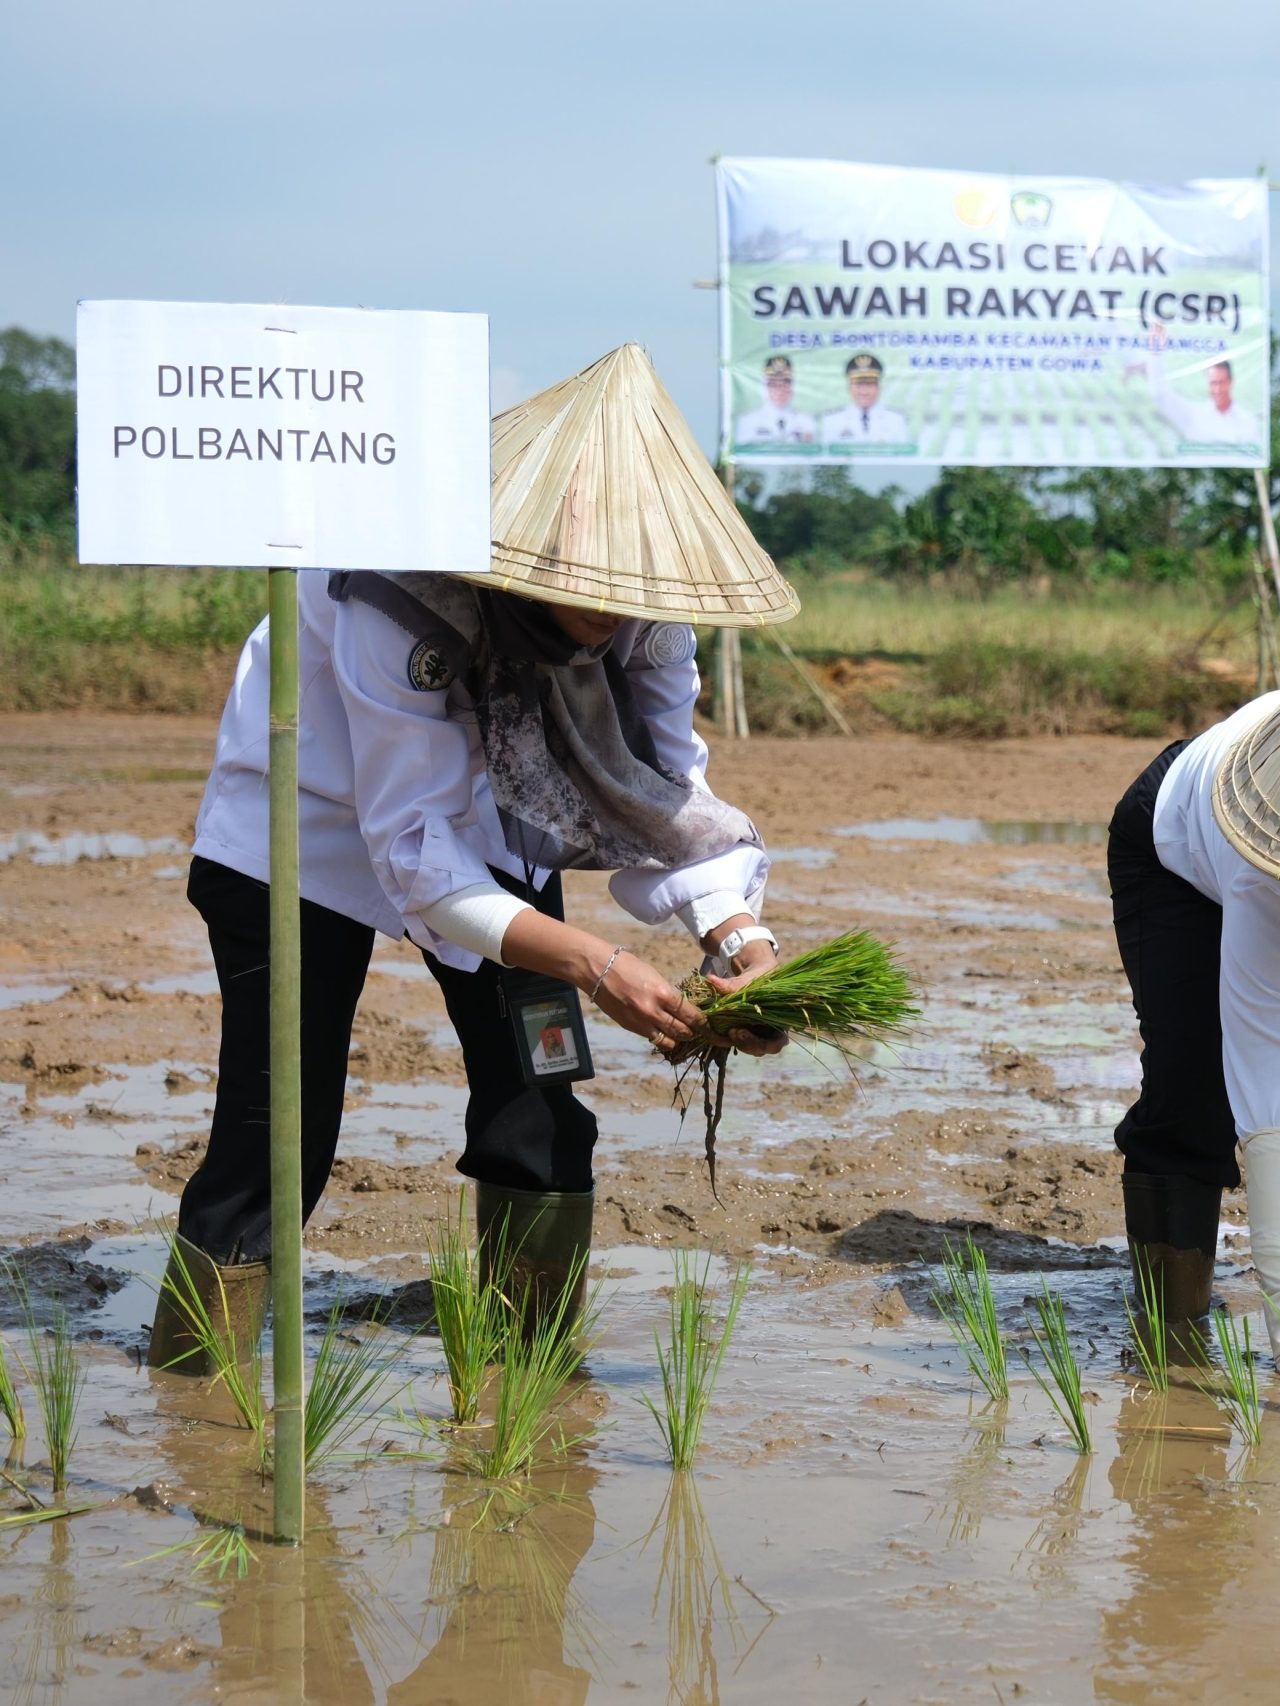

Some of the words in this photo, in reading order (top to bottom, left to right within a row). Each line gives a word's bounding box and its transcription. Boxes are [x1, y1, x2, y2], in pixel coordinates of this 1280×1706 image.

[842, 239, 1005, 270] LOKASI
[1024, 243, 1167, 275] CETAK
[753, 285, 927, 319] SAWAH
[946, 286, 1123, 319] RAKYAT
[1139, 289, 1241, 332] (CSR)
[158, 365, 365, 403] DIREKTUR
[113, 426, 396, 465] POLBANTANG
